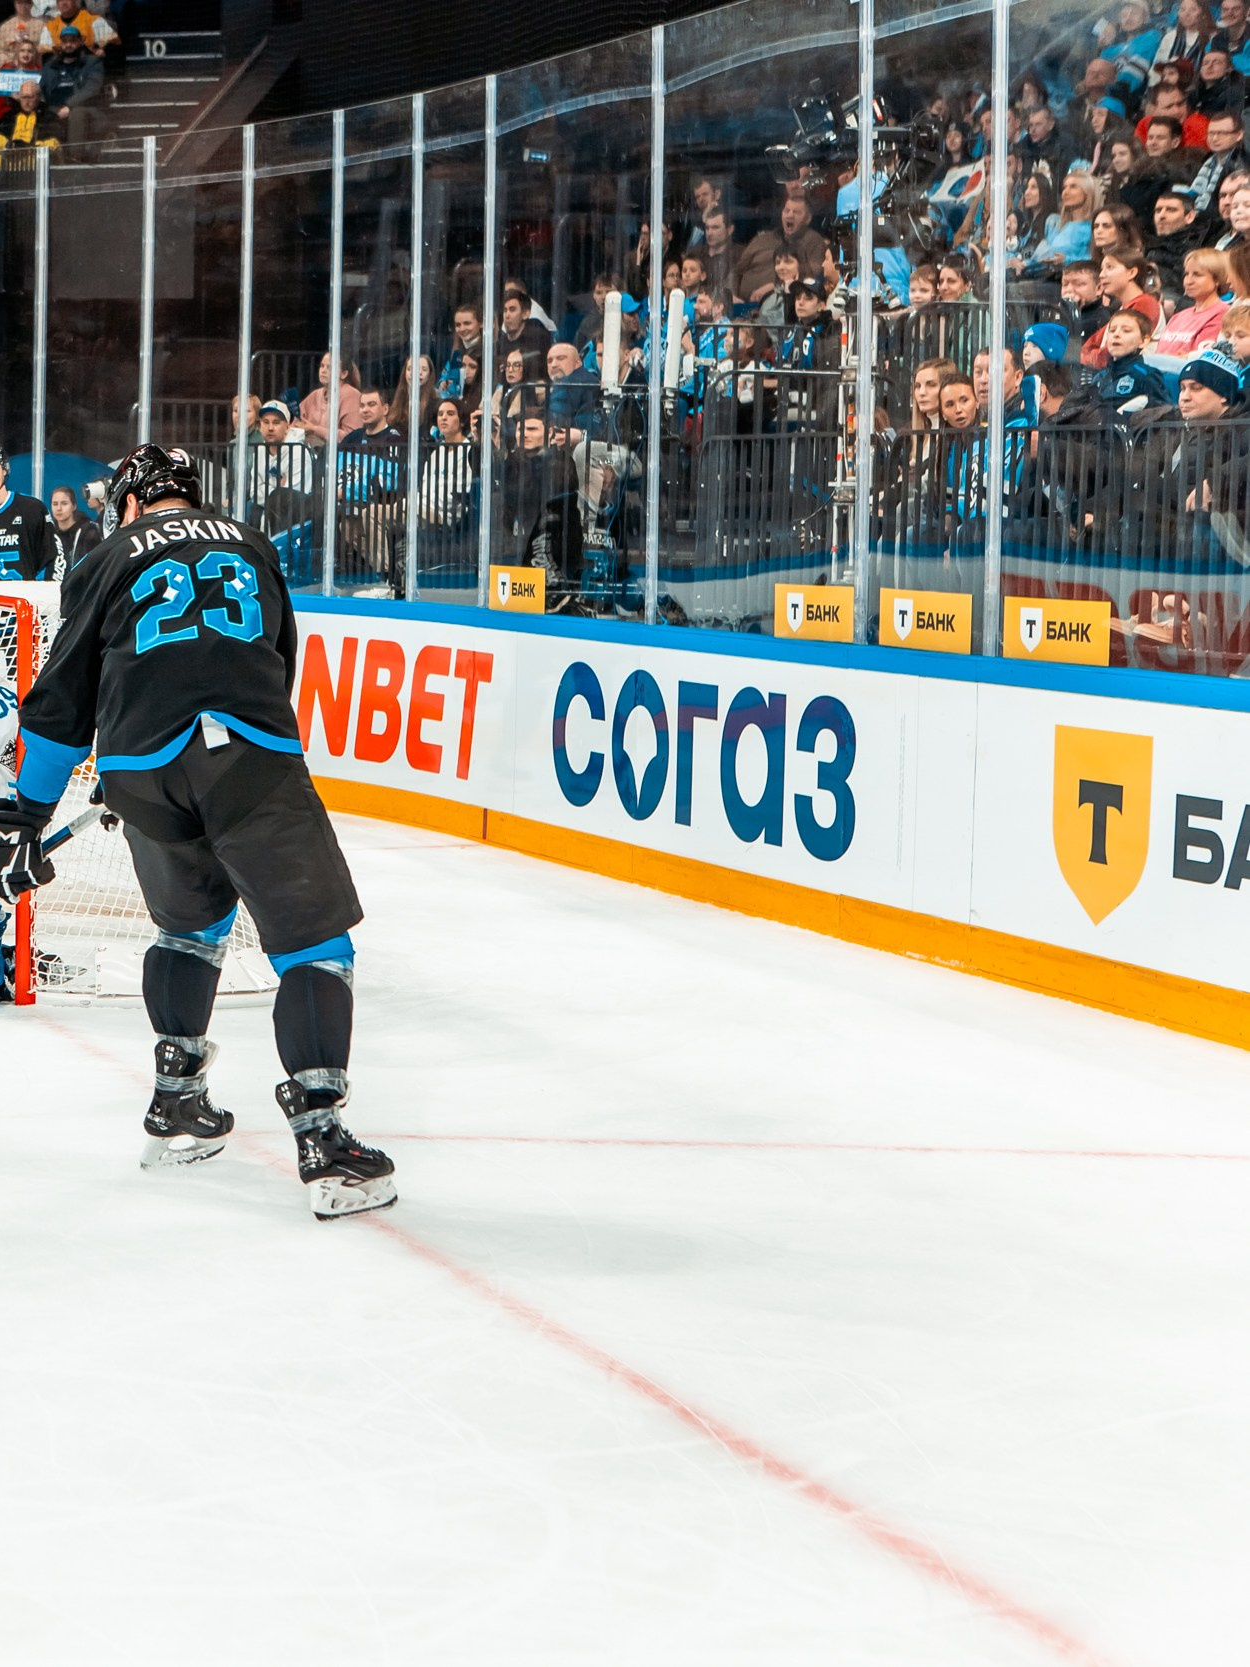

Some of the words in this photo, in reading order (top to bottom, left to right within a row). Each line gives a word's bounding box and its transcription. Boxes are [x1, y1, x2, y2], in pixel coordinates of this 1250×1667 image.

[145, 40, 166, 58] 10
[129, 518, 244, 558] JASKIN
[512, 582, 536, 598] БАНК
[130, 551, 264, 655] 23
[806, 604, 840, 623] БАНК
[916, 611, 956, 633] БАНК
[1046, 621, 1091, 643] БАНК
[297, 634, 494, 780] NBET
[553, 661, 857, 862] согаз
